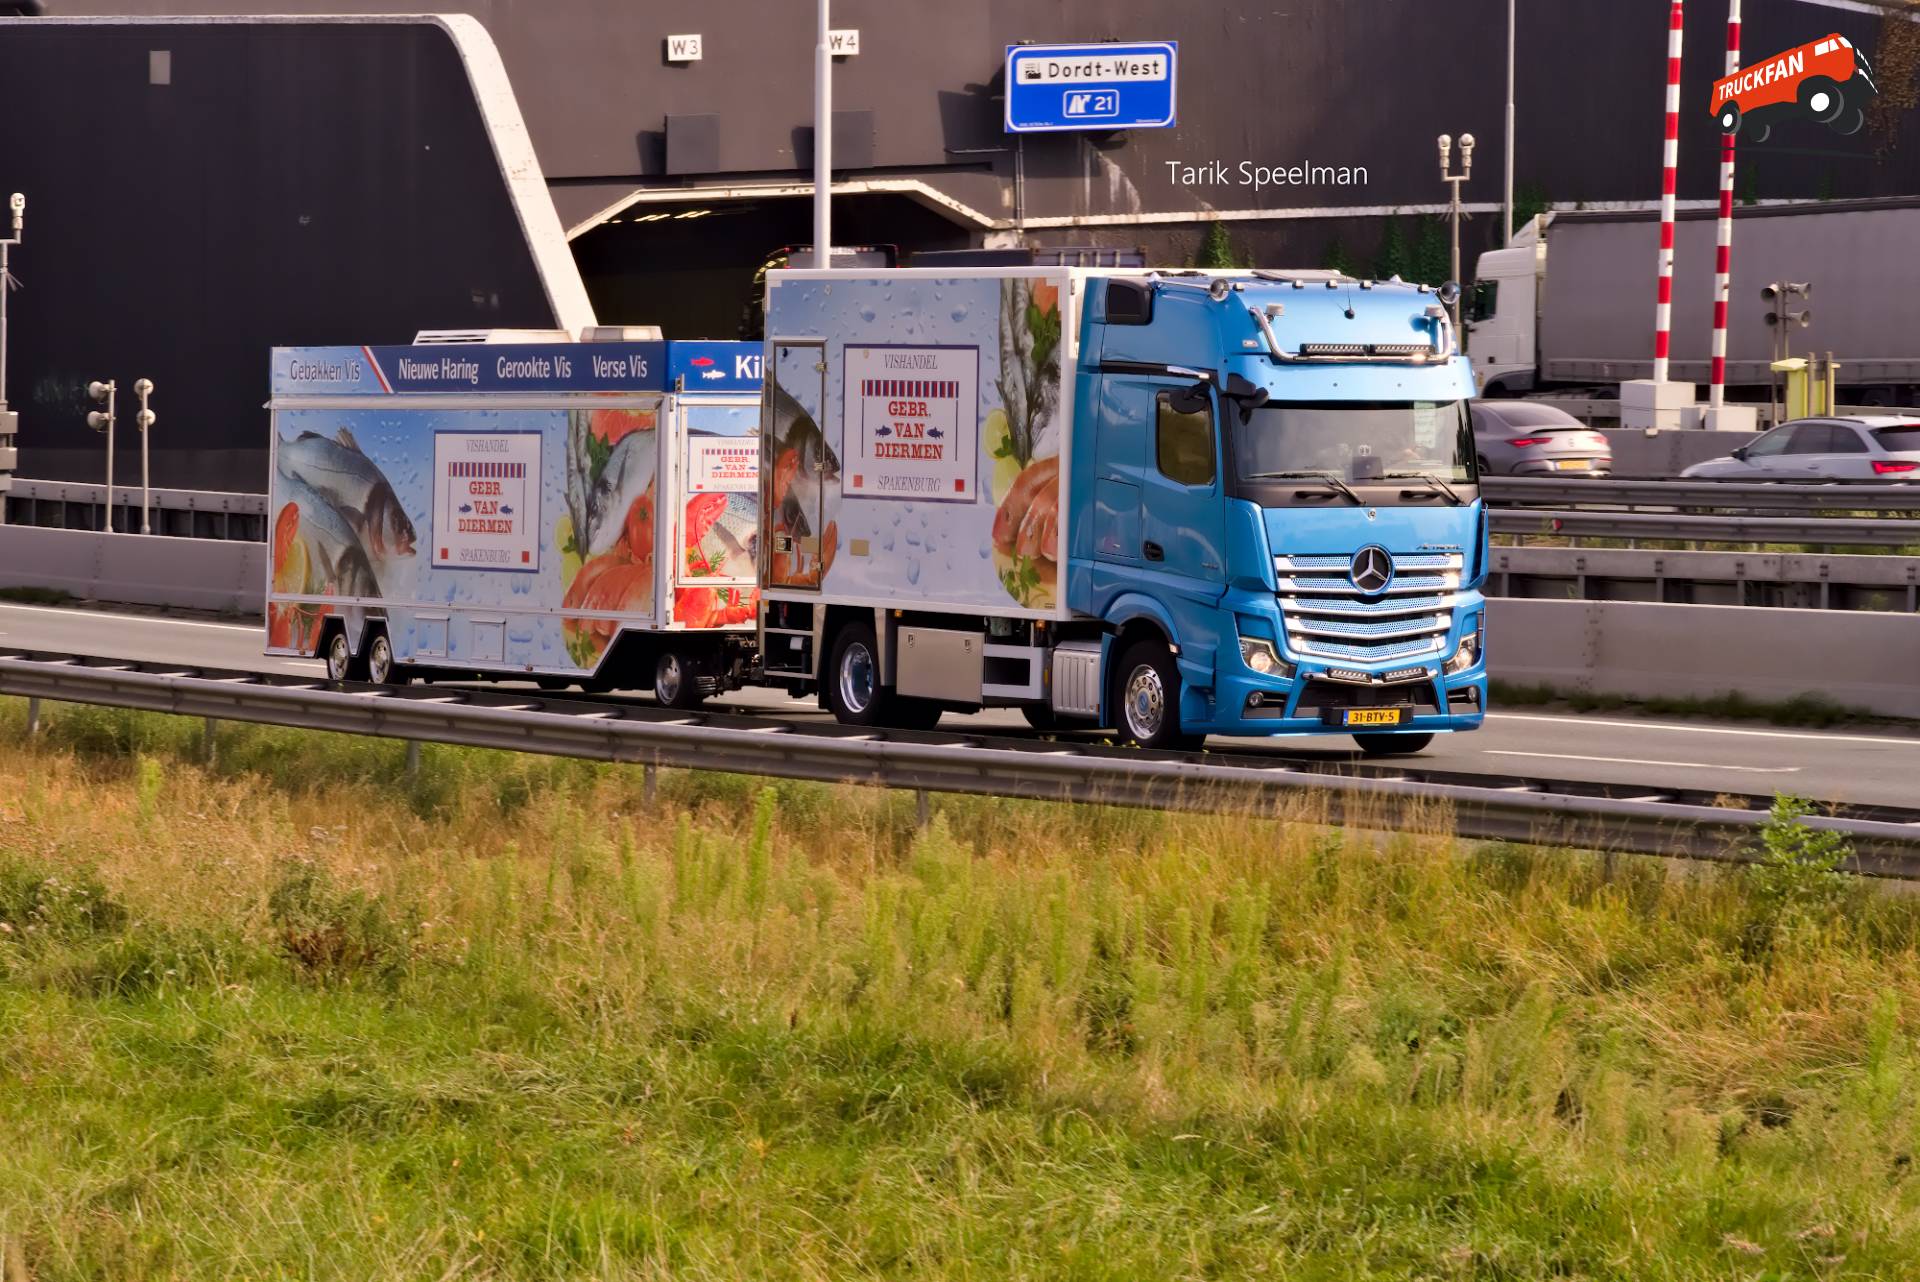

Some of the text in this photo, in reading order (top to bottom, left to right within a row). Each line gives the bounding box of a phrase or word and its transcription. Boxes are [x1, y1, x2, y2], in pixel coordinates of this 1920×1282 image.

[1048, 60, 1160, 78] Dordt-West
[1094, 96, 1112, 111] 21
[290, 359, 361, 382] Gebakken Vis
[399, 357, 479, 384] Nieuwe Haring
[497, 355, 572, 378] Gerookte Vis
[592, 355, 648, 378] Verse Vis
[884, 354, 938, 370] VISHANDEL
[888, 400, 932, 418] GEBR.
[894, 422, 926, 438] VAN
[465, 439, 509, 453] VISHANDEL
[875, 442, 944, 460] DIERMEN
[877, 475, 941, 493] SPAKENBURG
[473, 500, 499, 515] VAN
[458, 518, 513, 534] DIERMEN
[459, 547, 511, 563] SPAKENBURG
[1352, 712, 1394, 722] 31-BTV-5
